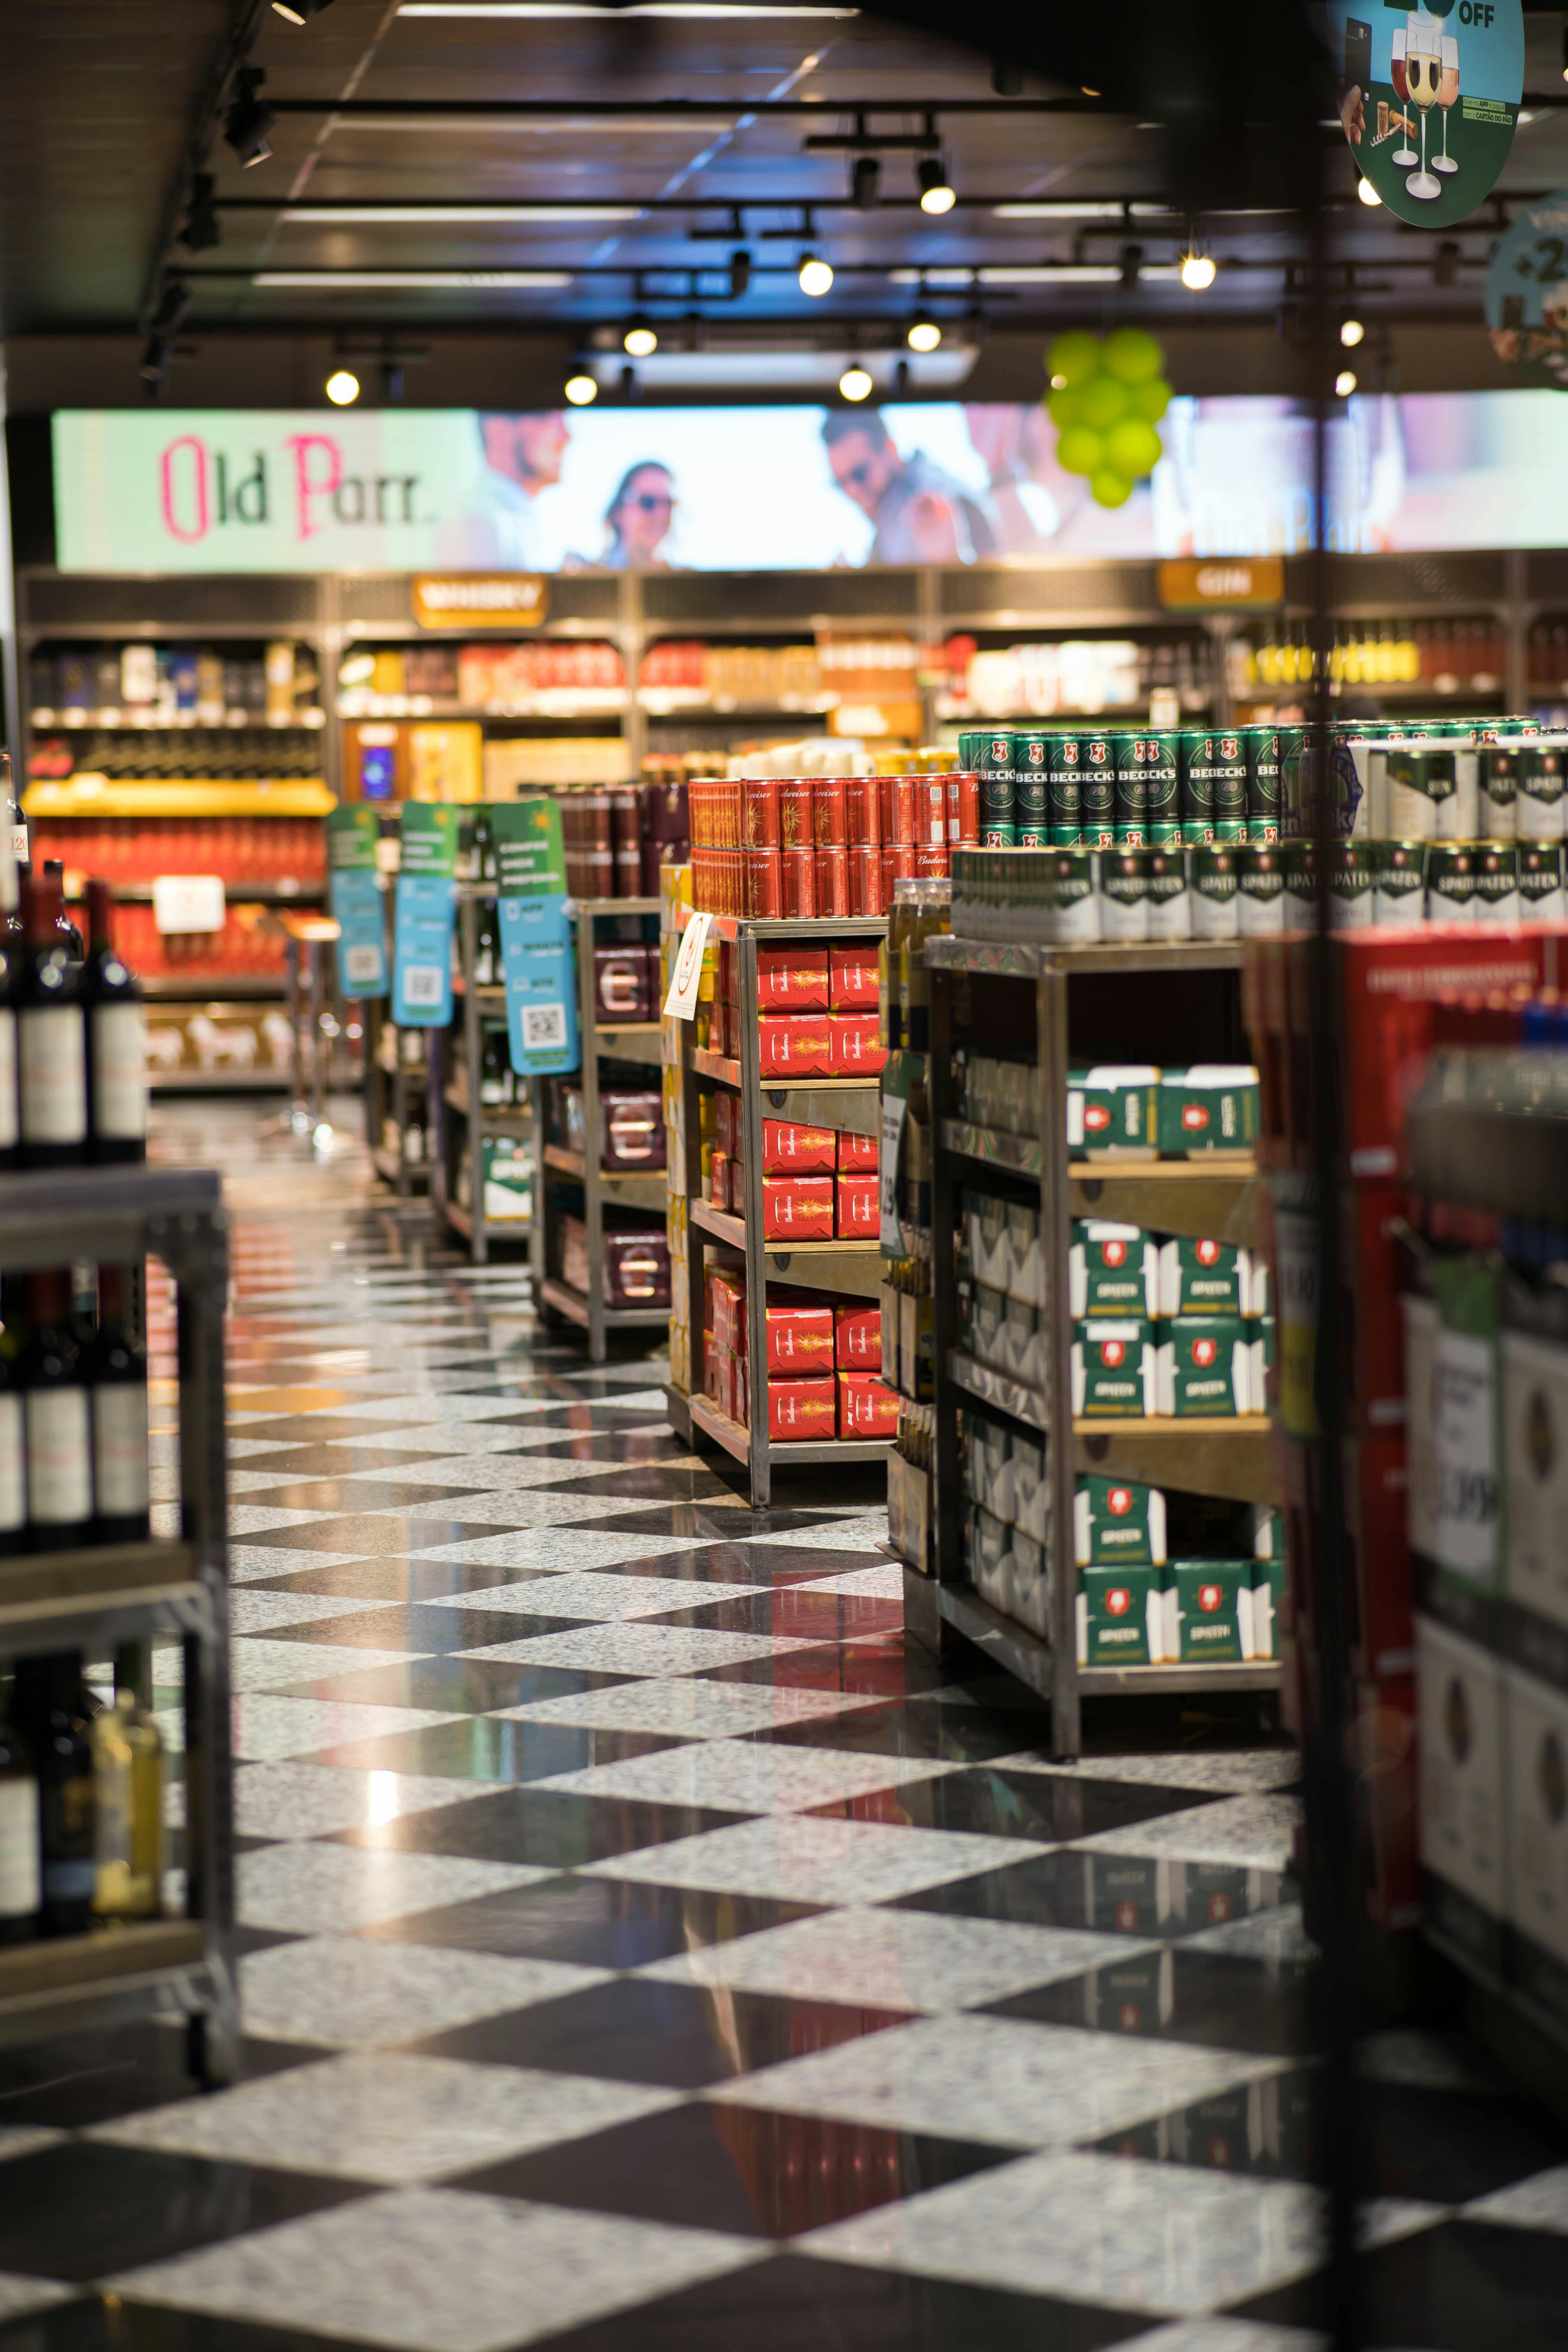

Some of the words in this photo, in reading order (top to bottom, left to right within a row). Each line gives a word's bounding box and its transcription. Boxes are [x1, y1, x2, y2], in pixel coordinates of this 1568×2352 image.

[1458, 0, 1495, 28] OFF
[1476, 112, 1494, 121] CARTÃO
[1502, 115, 1511, 124] PÃO
[160, 434, 270, 544] Old
[286, 434, 423, 542] Parr
